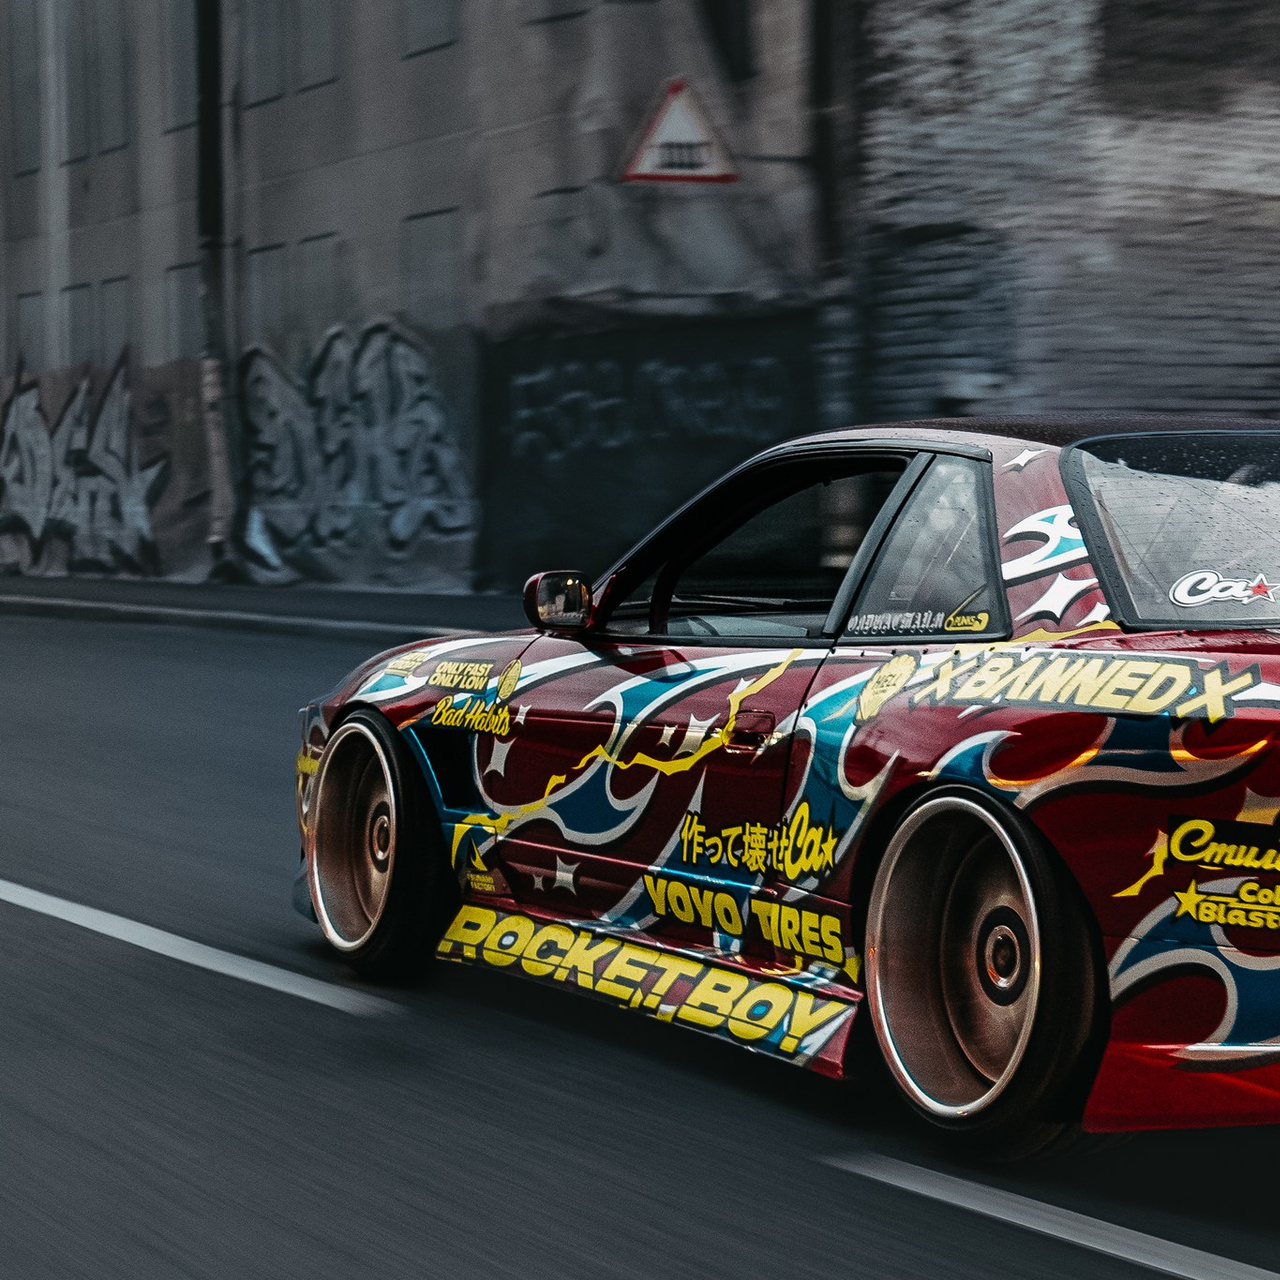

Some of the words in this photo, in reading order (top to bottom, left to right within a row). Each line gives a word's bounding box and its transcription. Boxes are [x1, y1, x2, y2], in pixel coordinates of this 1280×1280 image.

[428, 673, 463, 688] ONLY
[458, 676, 489, 691] LOW
[435, 661, 468, 675] ONLY
[463, 663, 494, 677] FAST
[431, 695, 472, 727] Bad
[464, 698, 511, 737] Habits
[643, 874, 743, 936] YOYO
[750, 899, 844, 964] TIRES
